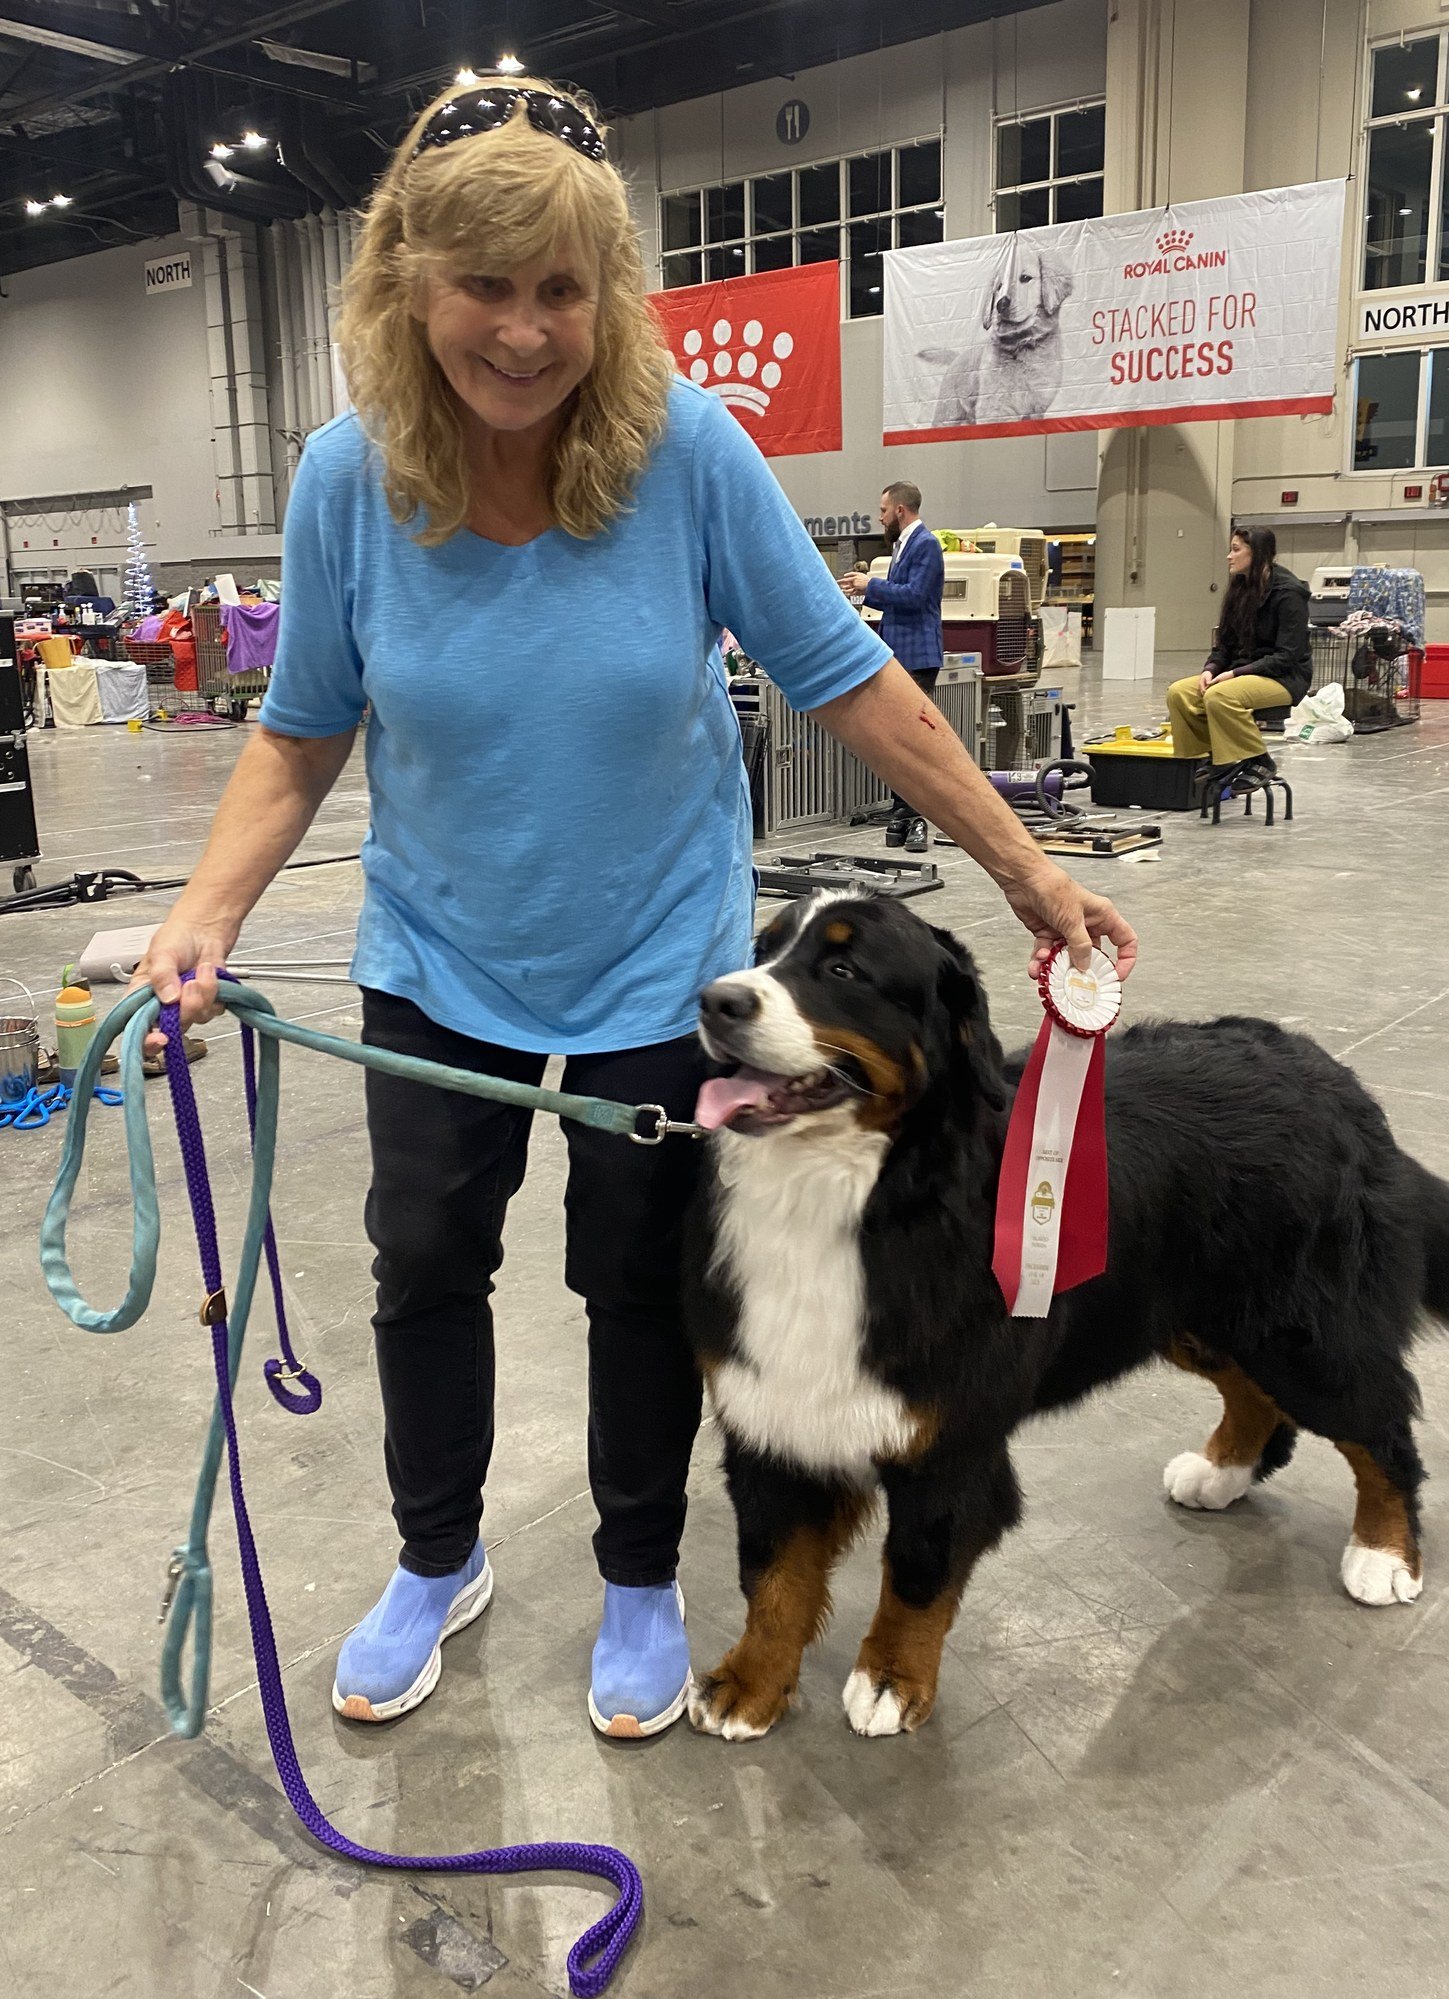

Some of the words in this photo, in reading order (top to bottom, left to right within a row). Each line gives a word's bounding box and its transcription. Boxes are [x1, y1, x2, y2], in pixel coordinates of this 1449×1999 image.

[146, 260, 190, 286] NORTH
[1124, 258, 1171, 279] ROYAL
[1173, 250, 1226, 272] CANIN
[1092, 299, 1196, 345] STACKED
[1208, 292, 1257, 332] FOR
[1364, 300, 1449, 333] NORTH
[1110, 339, 1234, 386] SUCCESS
[803, 511, 872, 536] ments
